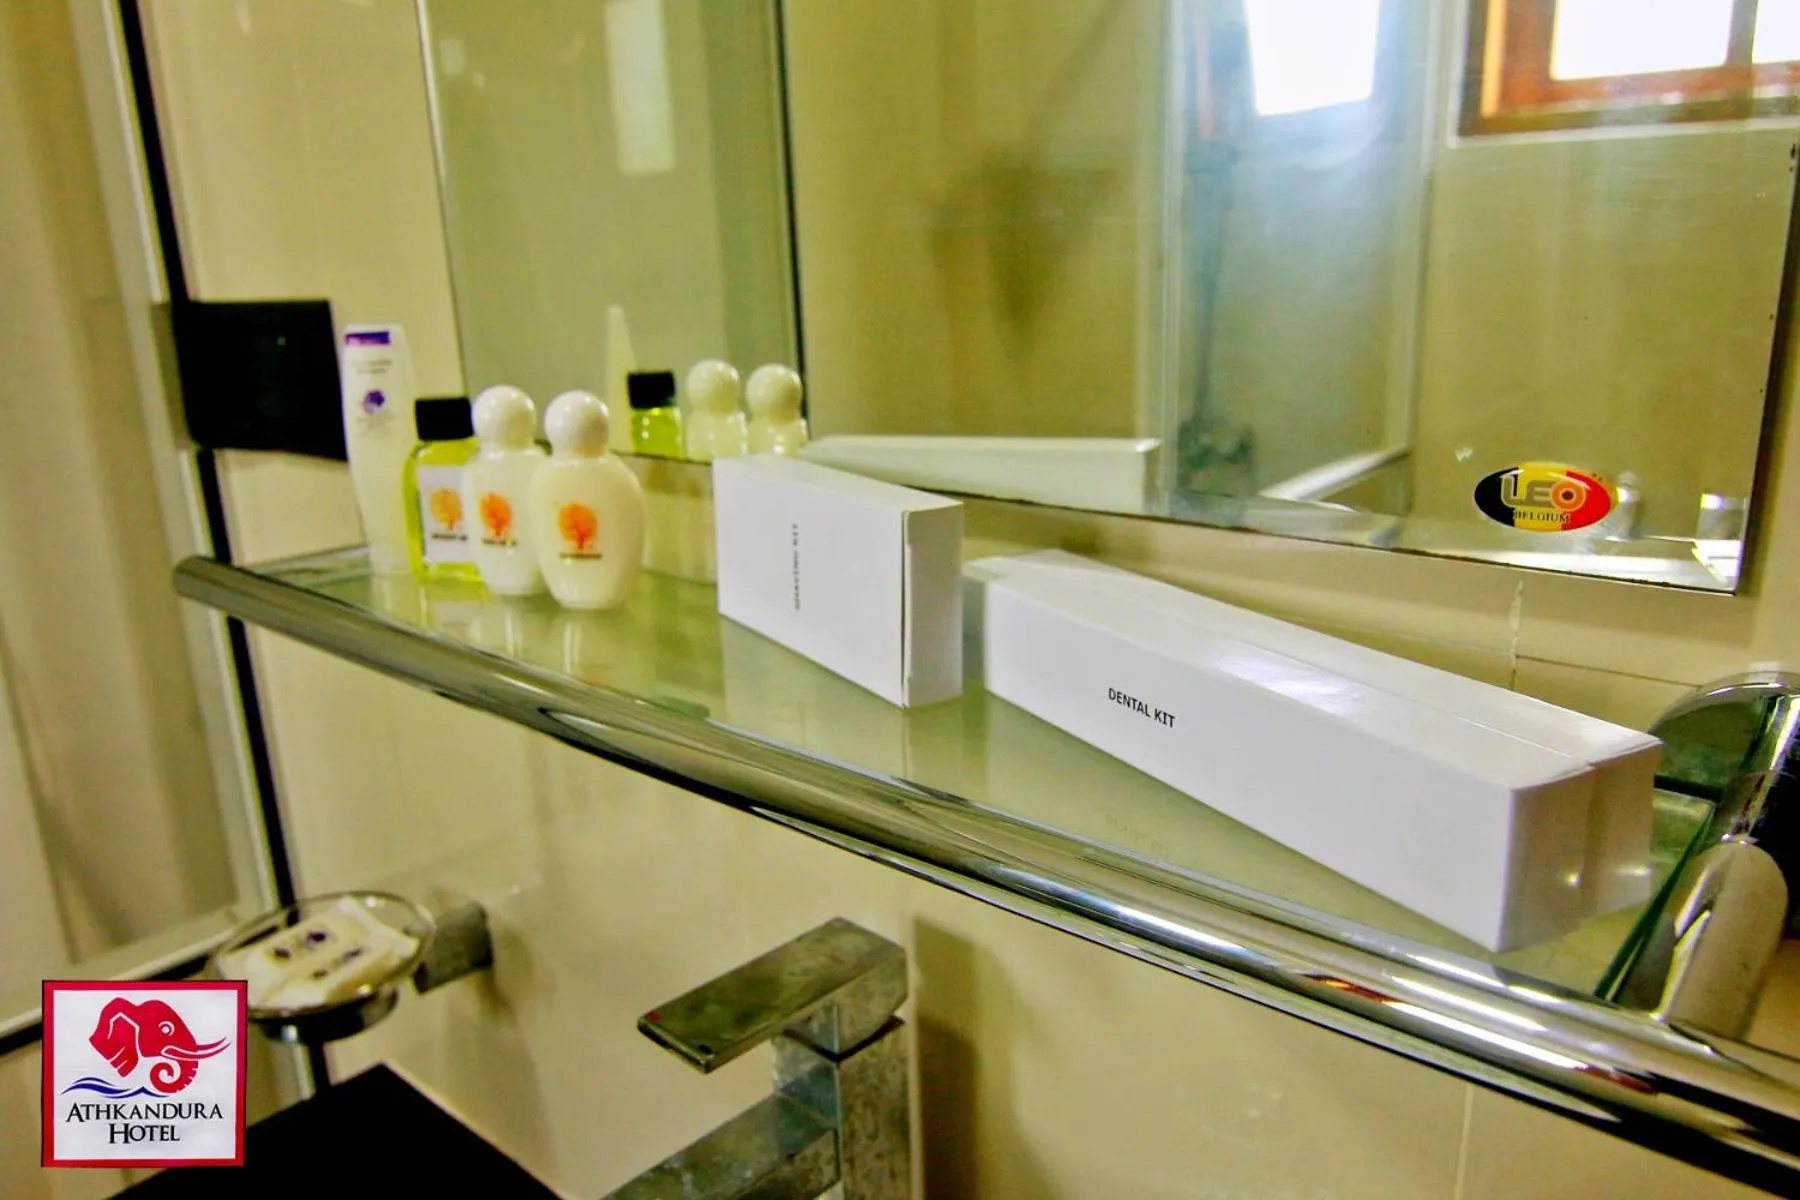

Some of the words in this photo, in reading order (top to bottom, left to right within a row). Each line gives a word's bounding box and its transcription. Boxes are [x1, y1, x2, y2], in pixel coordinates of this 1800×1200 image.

[1500, 474, 1587, 512] LEO
[1513, 509, 1572, 523] BELGIUM
[1108, 687, 1151, 718] DENTAL
[1154, 708, 1176, 728] KIT
